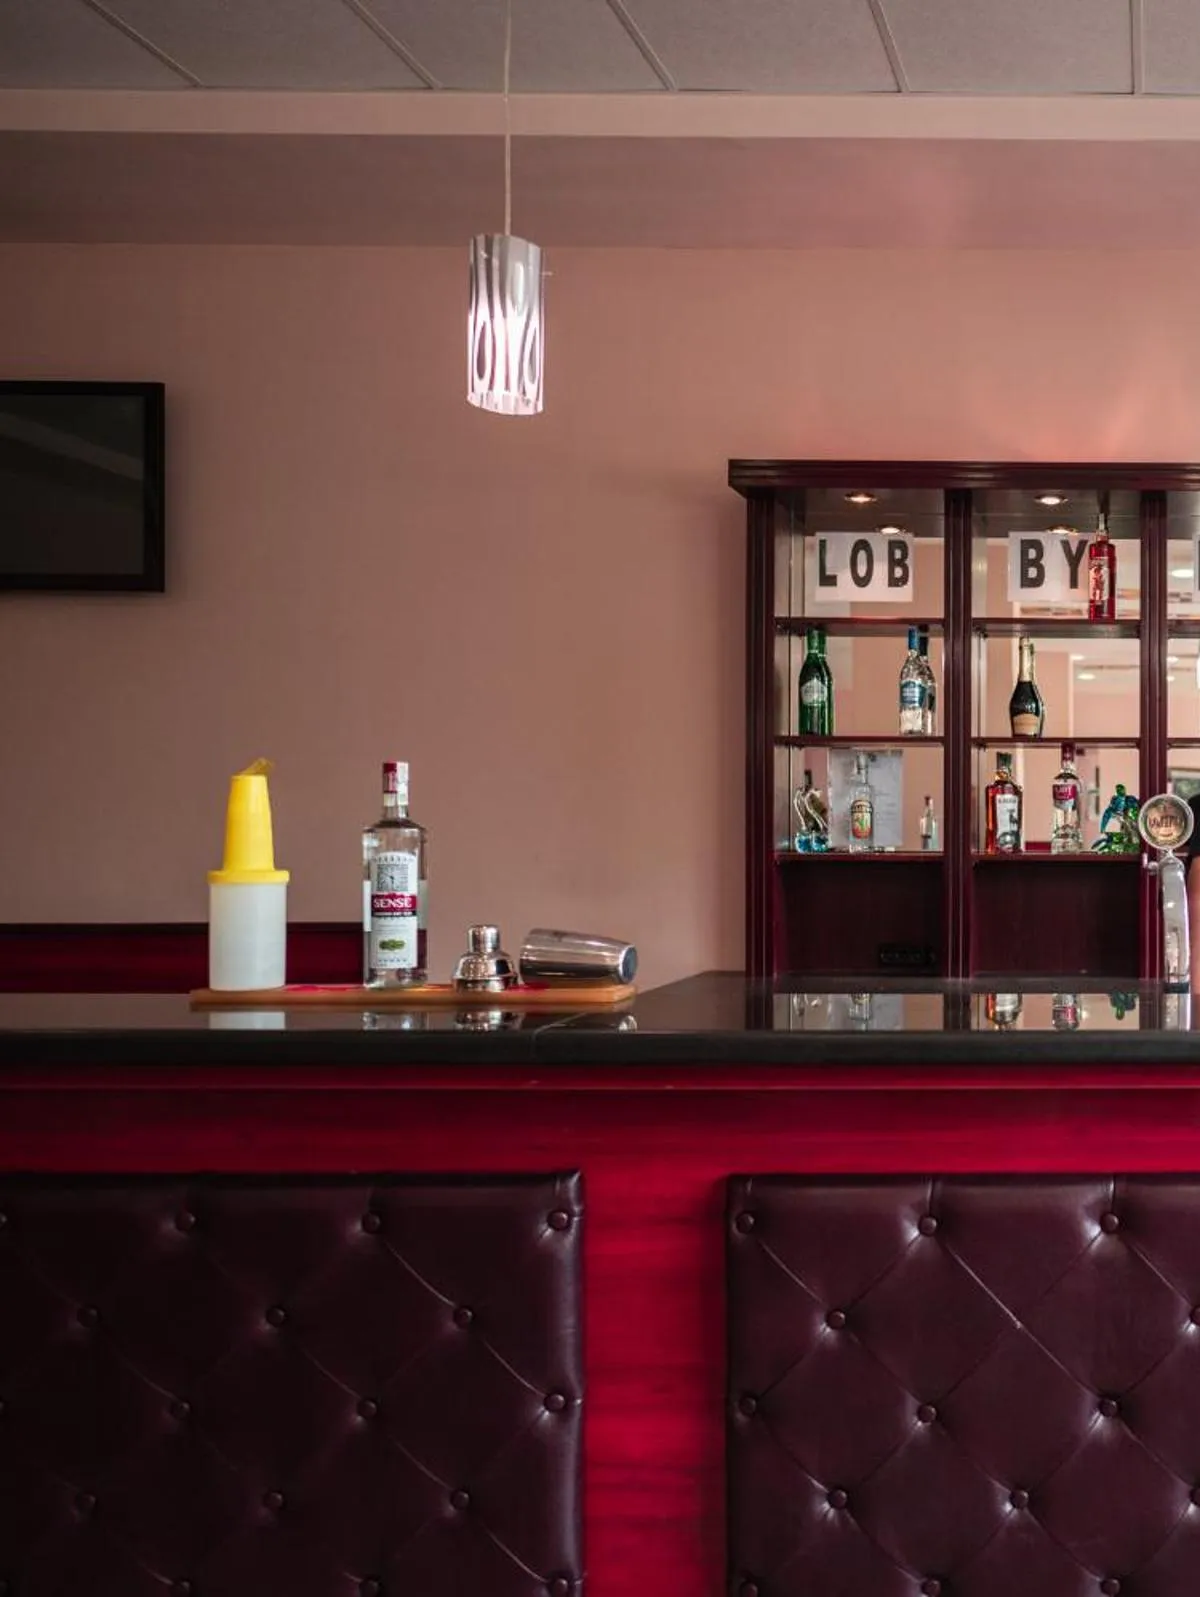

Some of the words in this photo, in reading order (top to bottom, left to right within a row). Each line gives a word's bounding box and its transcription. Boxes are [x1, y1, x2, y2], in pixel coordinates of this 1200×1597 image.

[818, 538, 909, 588] LOB
[1020, 539, 1089, 589] BY
[373, 897, 412, 908] SENSE
